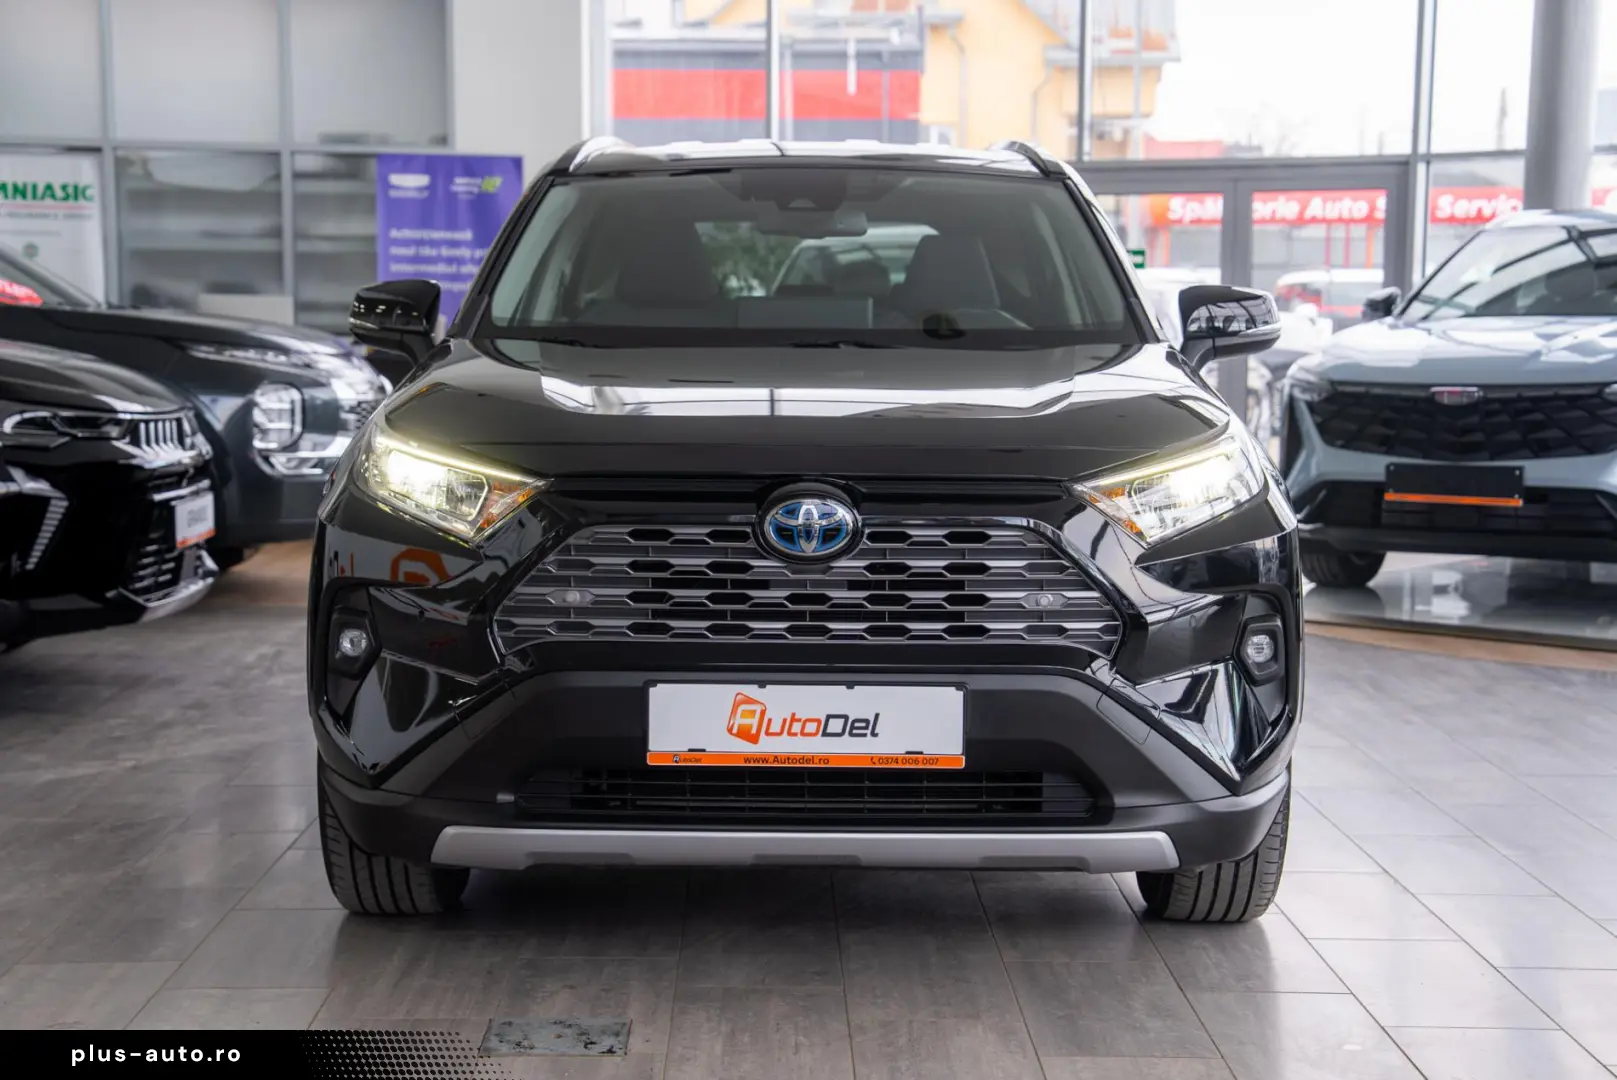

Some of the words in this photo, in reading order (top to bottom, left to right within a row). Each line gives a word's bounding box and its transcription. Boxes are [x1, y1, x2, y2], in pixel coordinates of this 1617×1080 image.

[1304, 196, 1369, 220] Auto
[727, 694, 880, 743] AutoDel
[743, 754, 829, 765] www.Autodel.ro
[878, 756, 899, 765] 0374
[901, 757, 920, 766] 006
[922, 757, 939, 766] 007
